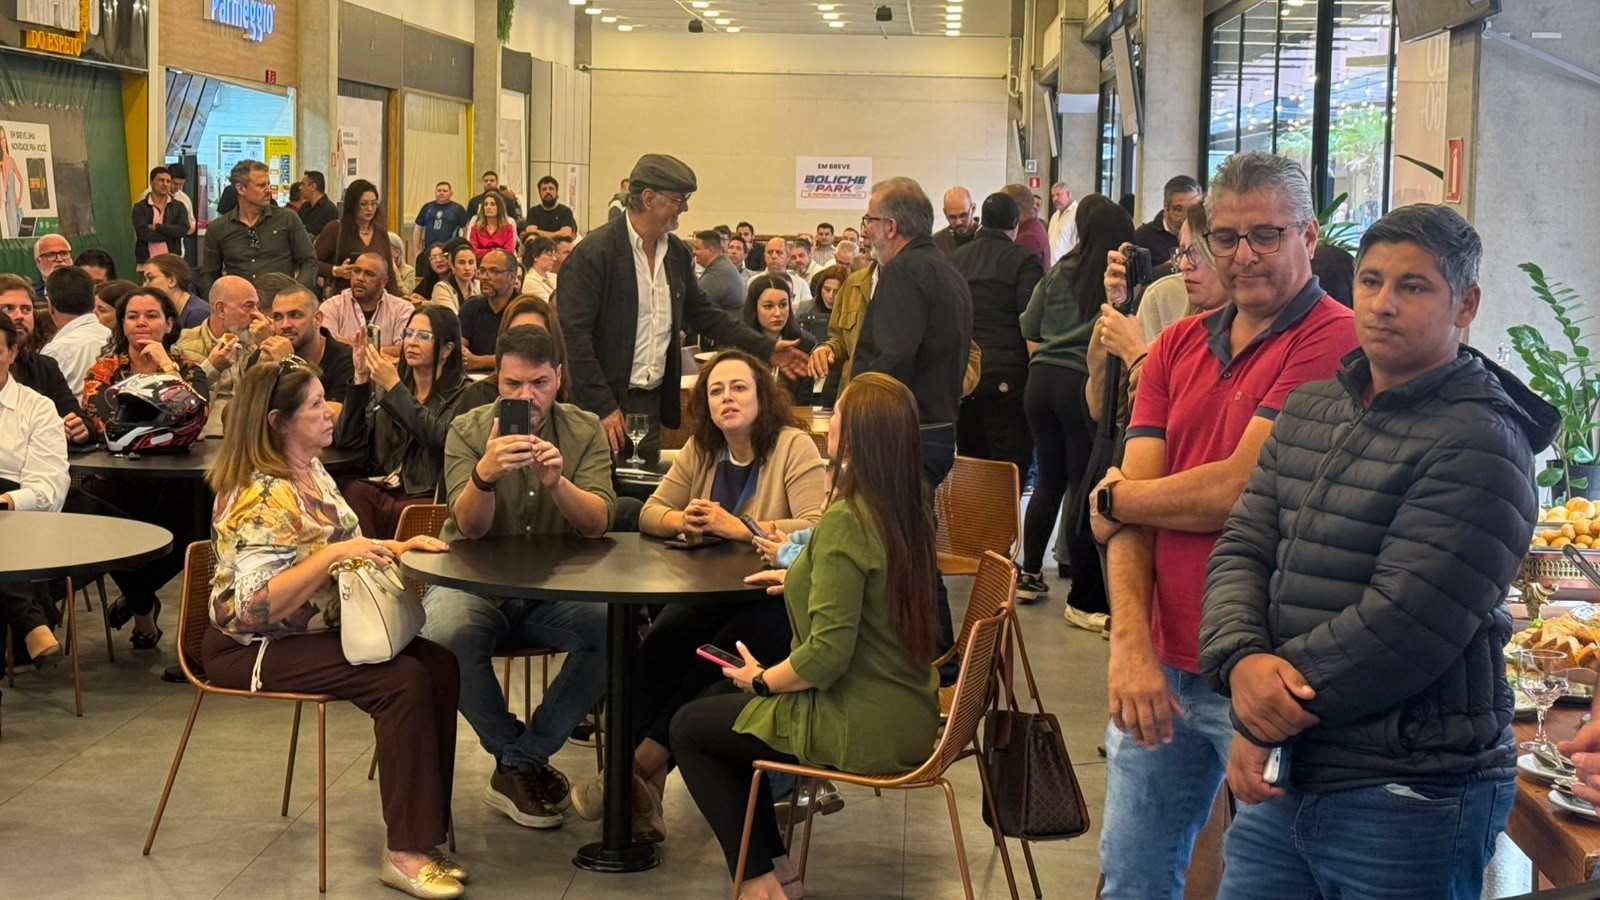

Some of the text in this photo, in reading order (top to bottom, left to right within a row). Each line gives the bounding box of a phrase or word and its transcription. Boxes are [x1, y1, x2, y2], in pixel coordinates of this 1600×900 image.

[31, 30, 82, 57] DO ESPETO
[804, 175, 867, 185] BOLICHE
[815, 184, 854, 193] PARK
